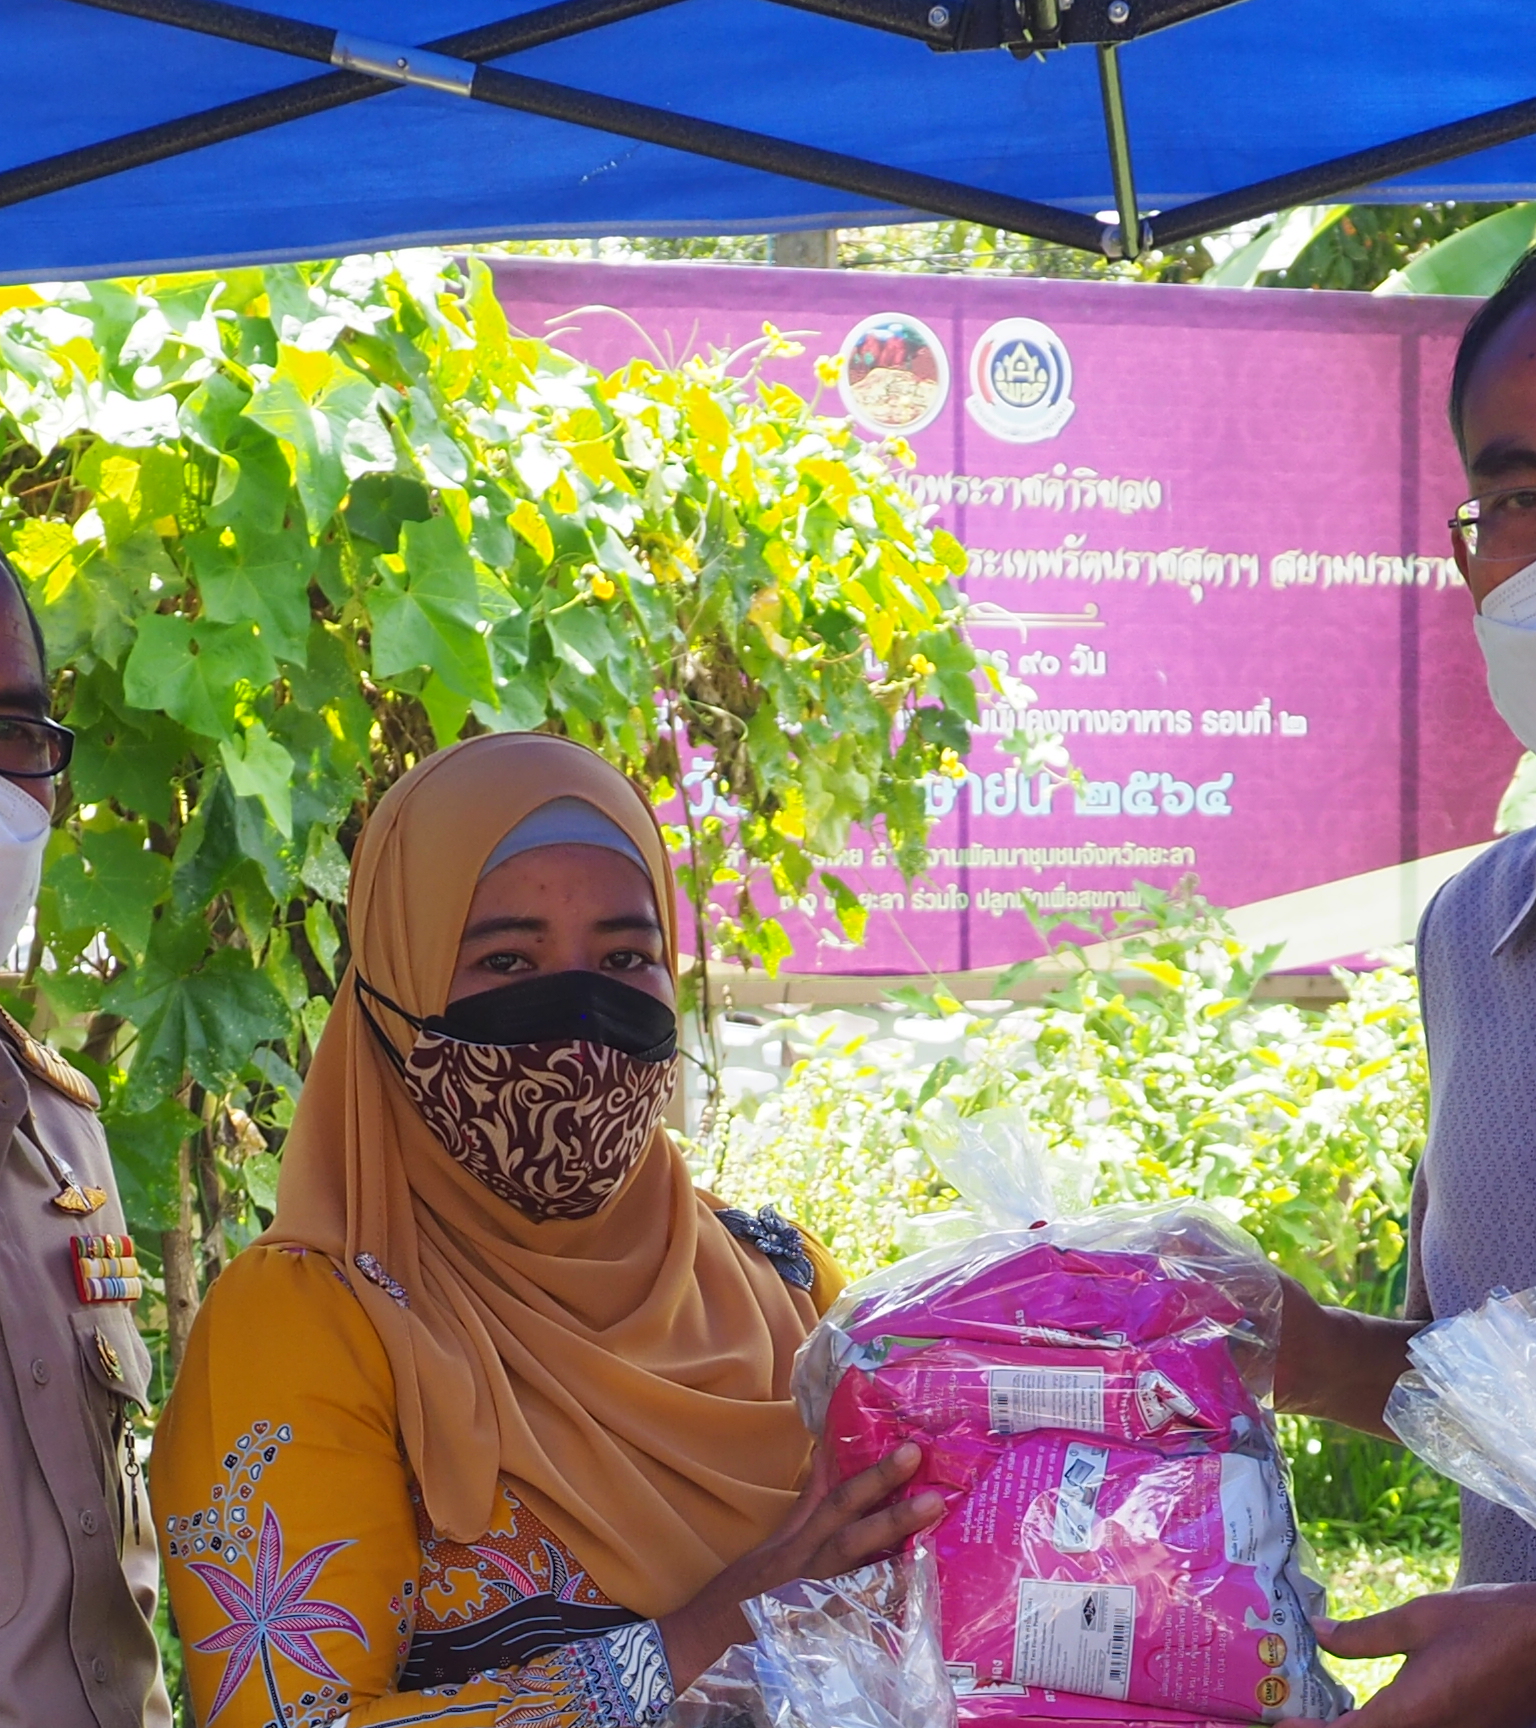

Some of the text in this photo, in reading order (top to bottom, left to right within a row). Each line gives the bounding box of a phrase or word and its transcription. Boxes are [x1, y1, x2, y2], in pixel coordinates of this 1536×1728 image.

[962, 533, 1259, 604] ระเทพรัตนราชสุดาฯ
[1069, 644, 1106, 677] วัน
[1201, 696, 1272, 736] รอบที่
[1074, 771, 1234, 818] ๒๕๖๔
